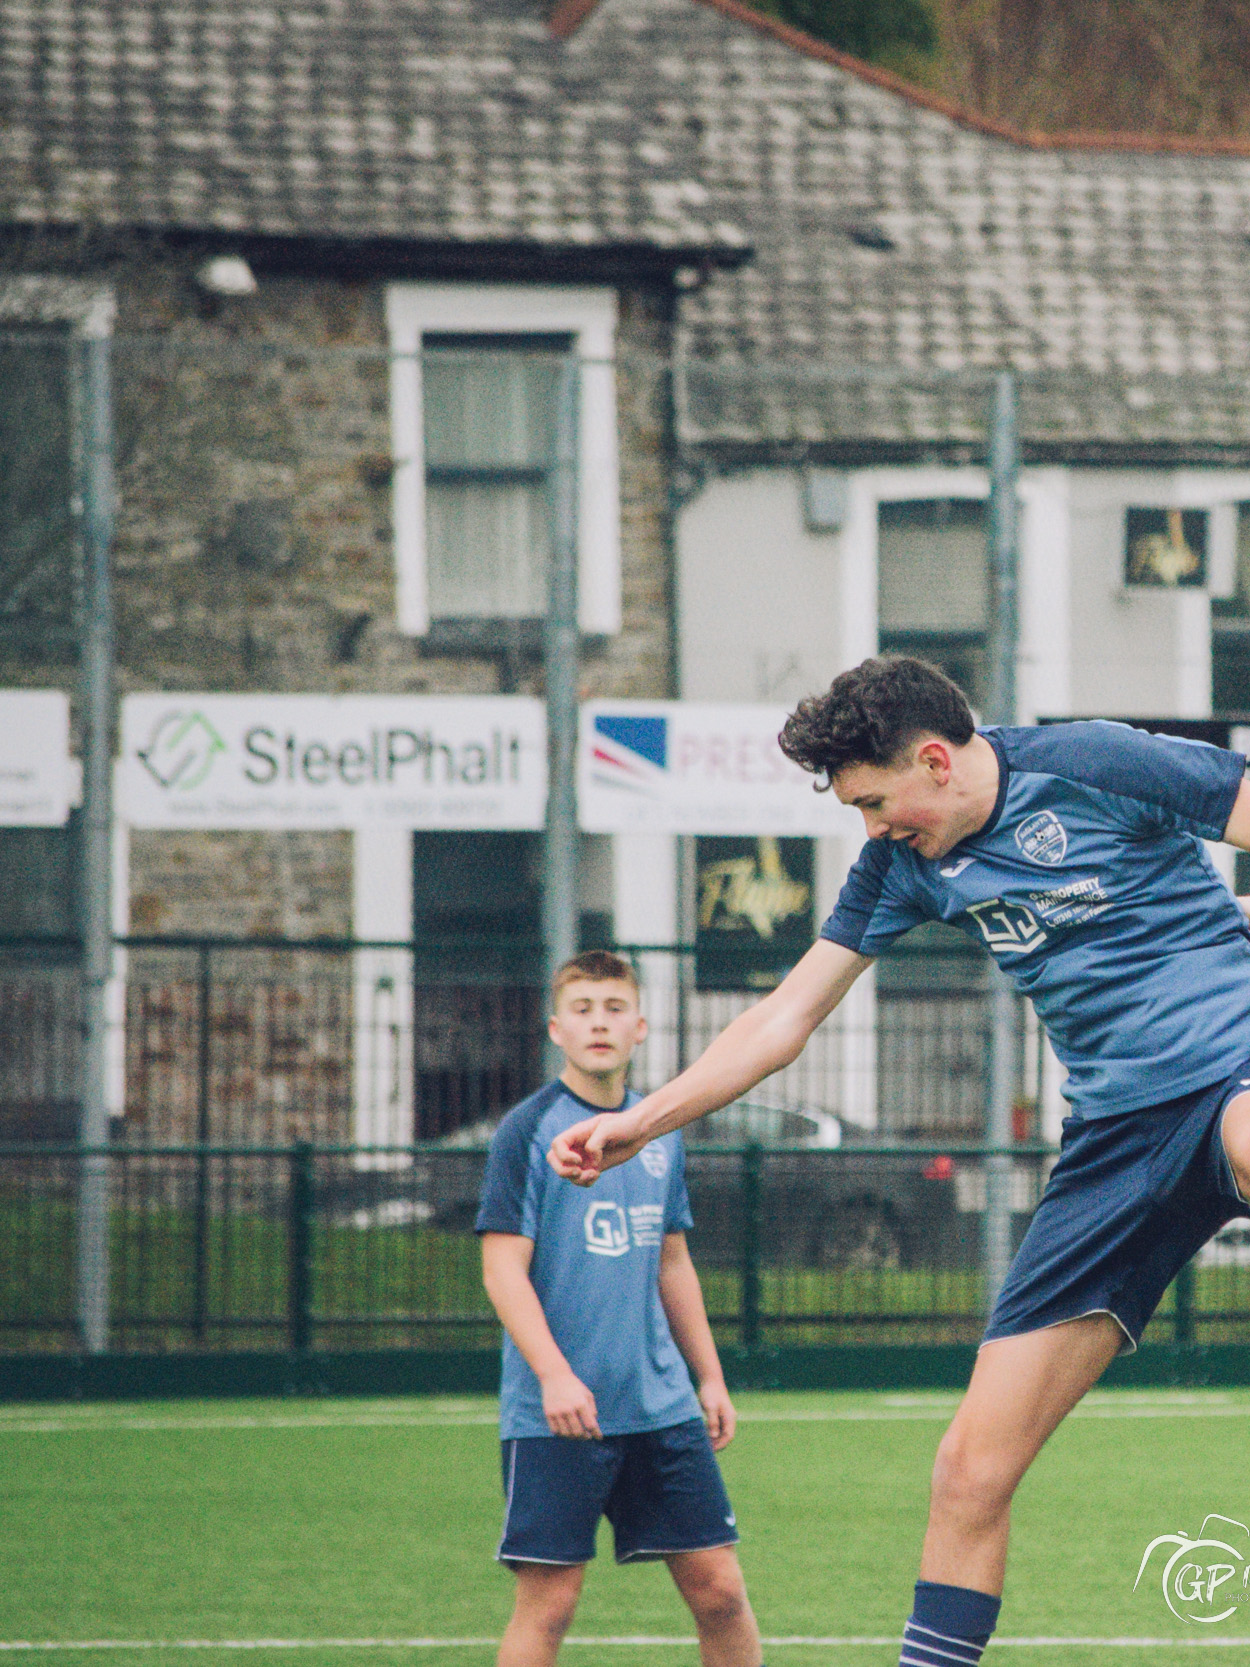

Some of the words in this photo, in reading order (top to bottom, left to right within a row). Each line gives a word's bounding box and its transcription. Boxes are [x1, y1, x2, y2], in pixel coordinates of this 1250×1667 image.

[245, 726, 521, 785] SteelPhalt
[679, 733, 811, 785] PRES
[1043, 877, 1099, 898] PROPERTY
